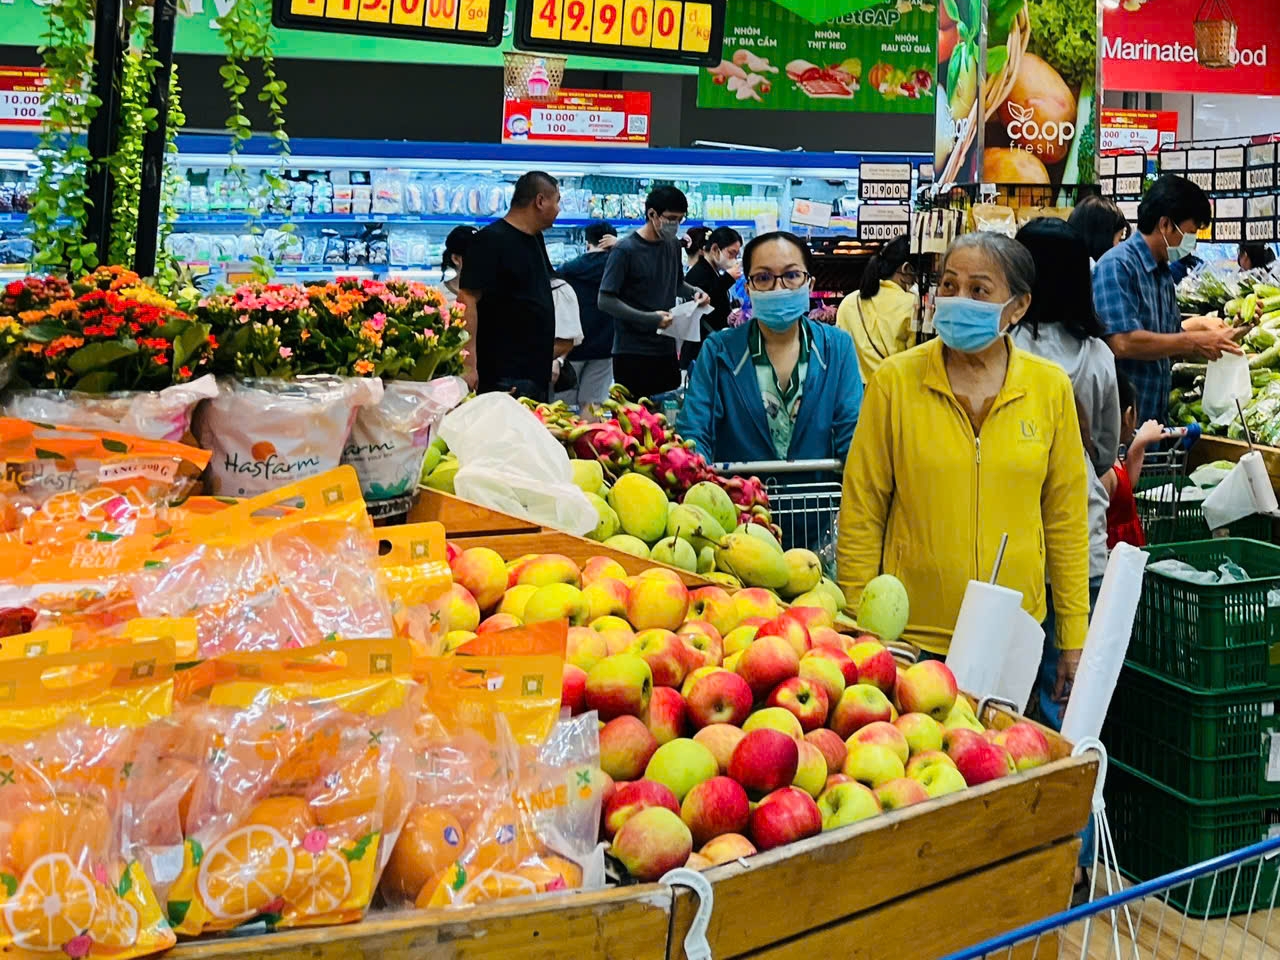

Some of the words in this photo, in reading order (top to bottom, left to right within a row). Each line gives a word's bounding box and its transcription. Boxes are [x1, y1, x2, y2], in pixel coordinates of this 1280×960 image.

[734, 26, 760, 36] NHÓM
[815, 30, 840, 39] NHÓM
[895, 33, 918, 43] NHÓM
[881, 43, 898, 52] RAU
[1231, 45, 1267, 66] ood
[540, 113, 575, 122] 10.000
[548, 124, 566, 133] 100
[1007, 120, 1075, 146] co.op
[1010, 141, 1054, 154] fresh
[864, 186, 900, 195] 31.900
[224, 452, 318, 480] Hasfarm
